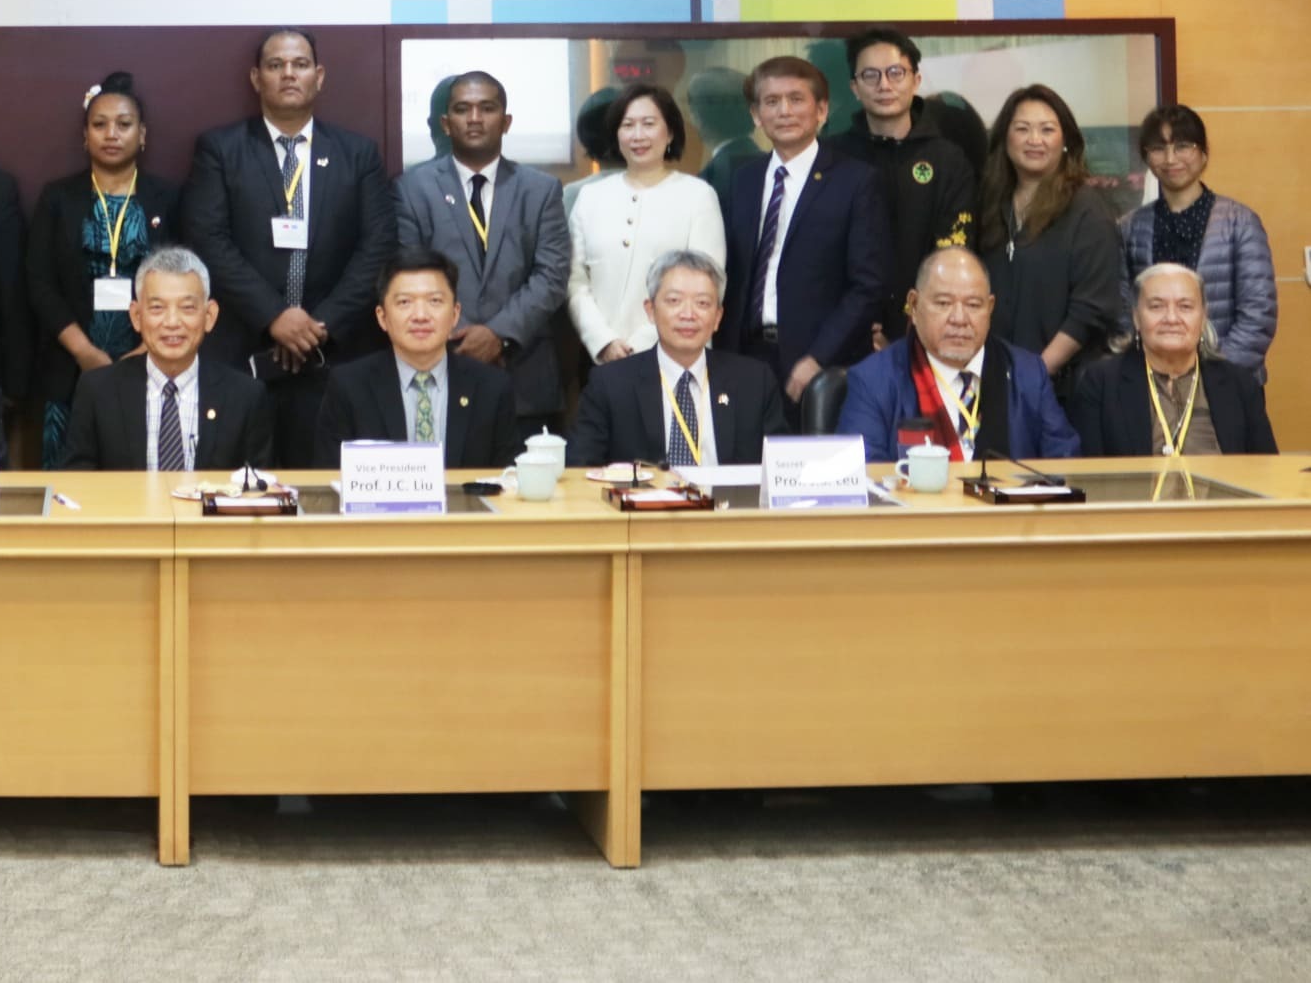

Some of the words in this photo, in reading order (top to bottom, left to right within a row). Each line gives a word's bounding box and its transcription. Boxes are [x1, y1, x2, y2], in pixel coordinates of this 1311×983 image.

[355, 463, 377, 474] Vice
[379, 463, 427, 474] President
[350, 479, 383, 492] Prof.
[386, 479, 410, 492] J.C.
[413, 479, 434, 492] Liu
